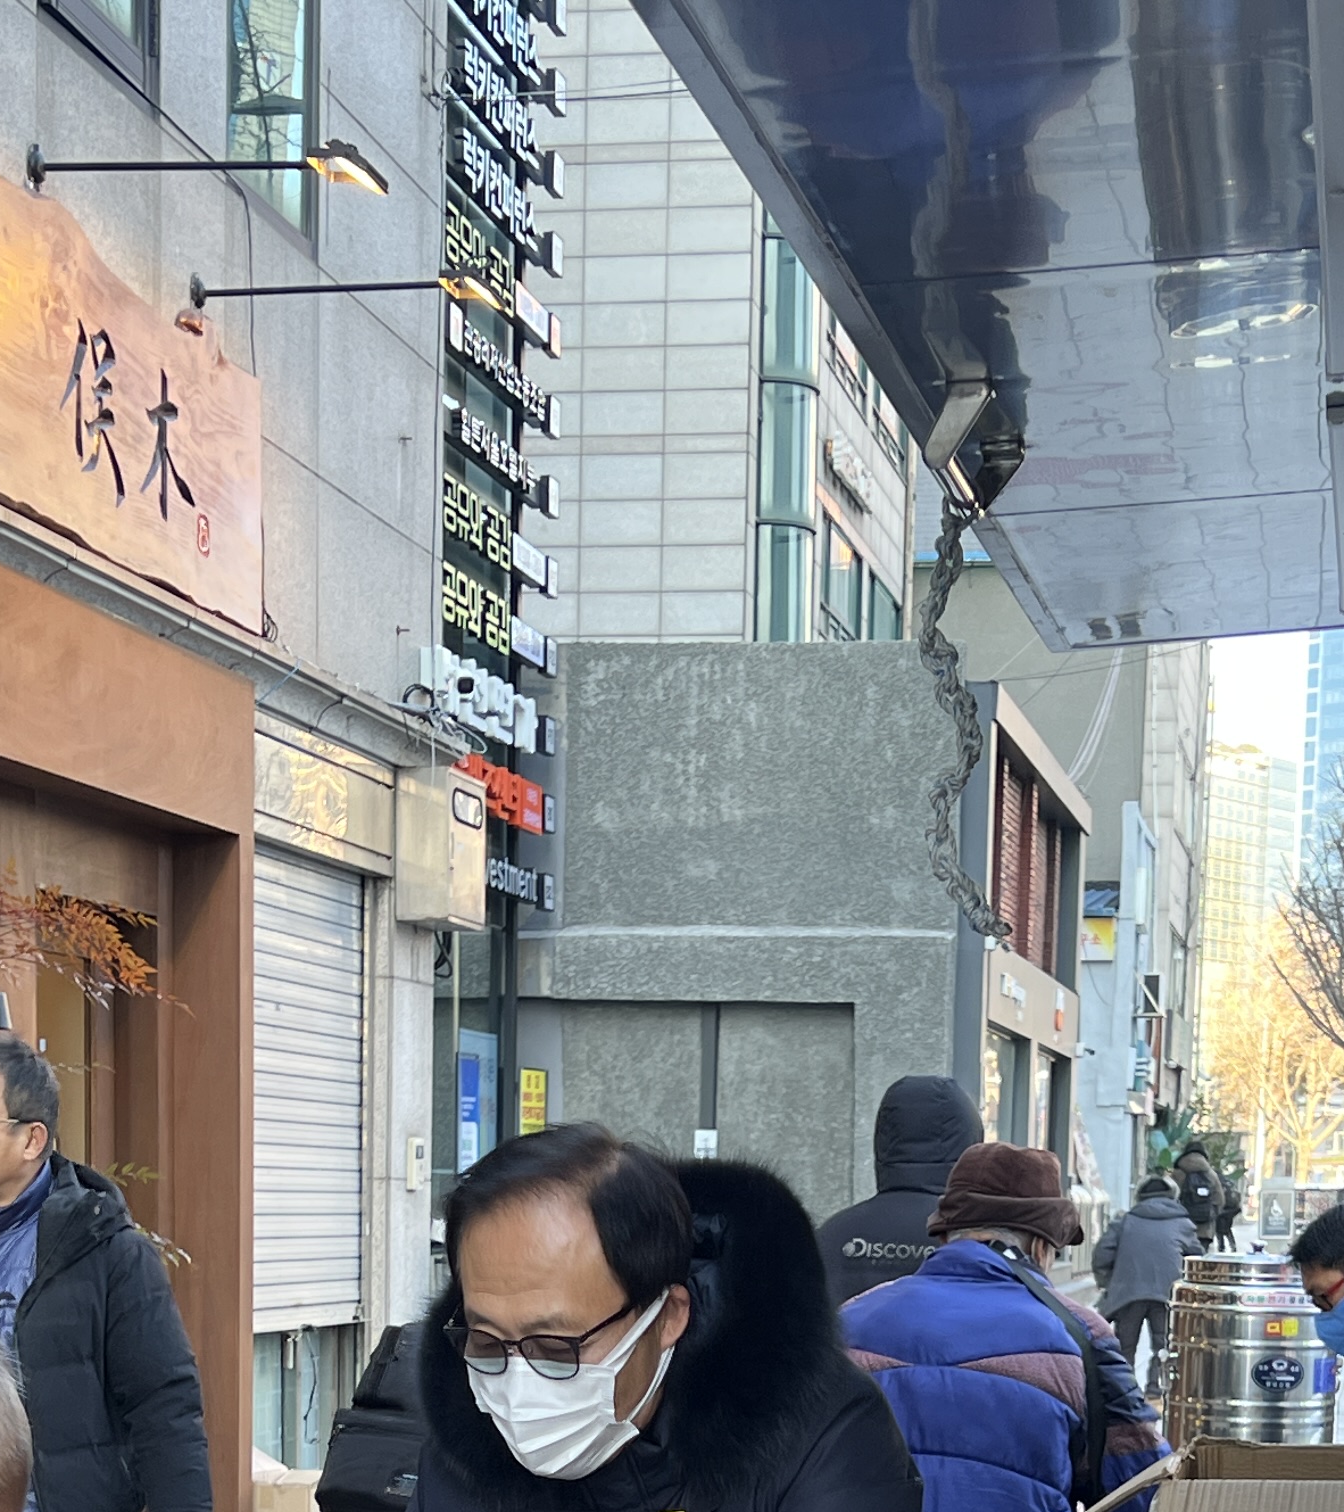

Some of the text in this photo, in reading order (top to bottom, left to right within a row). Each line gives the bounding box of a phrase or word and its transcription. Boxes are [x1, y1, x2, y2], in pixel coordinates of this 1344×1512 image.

[463, 127, 538, 252] 럭키컨퍼런스
[443, 472, 484, 551] 공유와
[487, 505, 512, 571] 공감
[442, 560, 484, 639] 공유와
[486, 589, 510, 655] 공감
